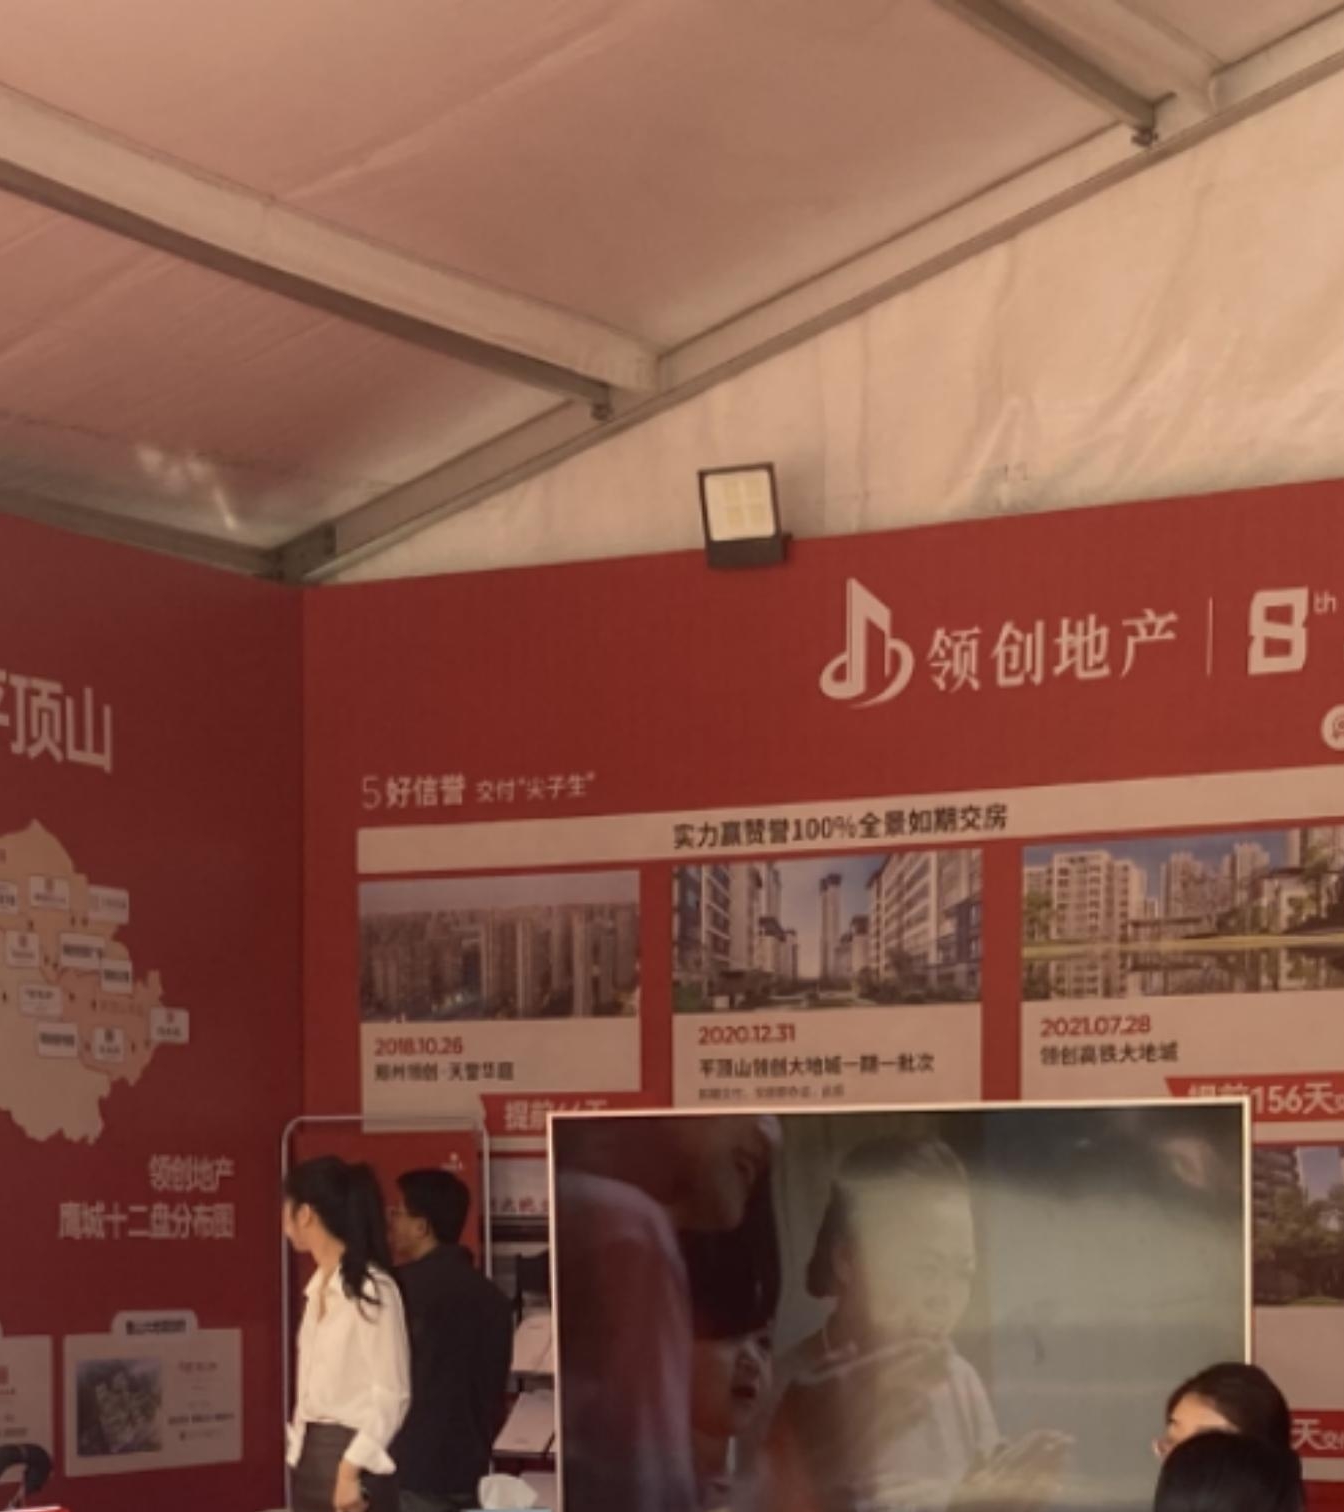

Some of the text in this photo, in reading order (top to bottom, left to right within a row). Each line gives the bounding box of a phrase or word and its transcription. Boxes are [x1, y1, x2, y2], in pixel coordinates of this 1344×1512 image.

[926, 608, 1178, 693] 领创地产
[698, 1023, 796, 1046] 2020.12.31
[1040, 1015, 1152, 1038] 2021.07.28
[148, 1155, 235, 1193] 领创地产
